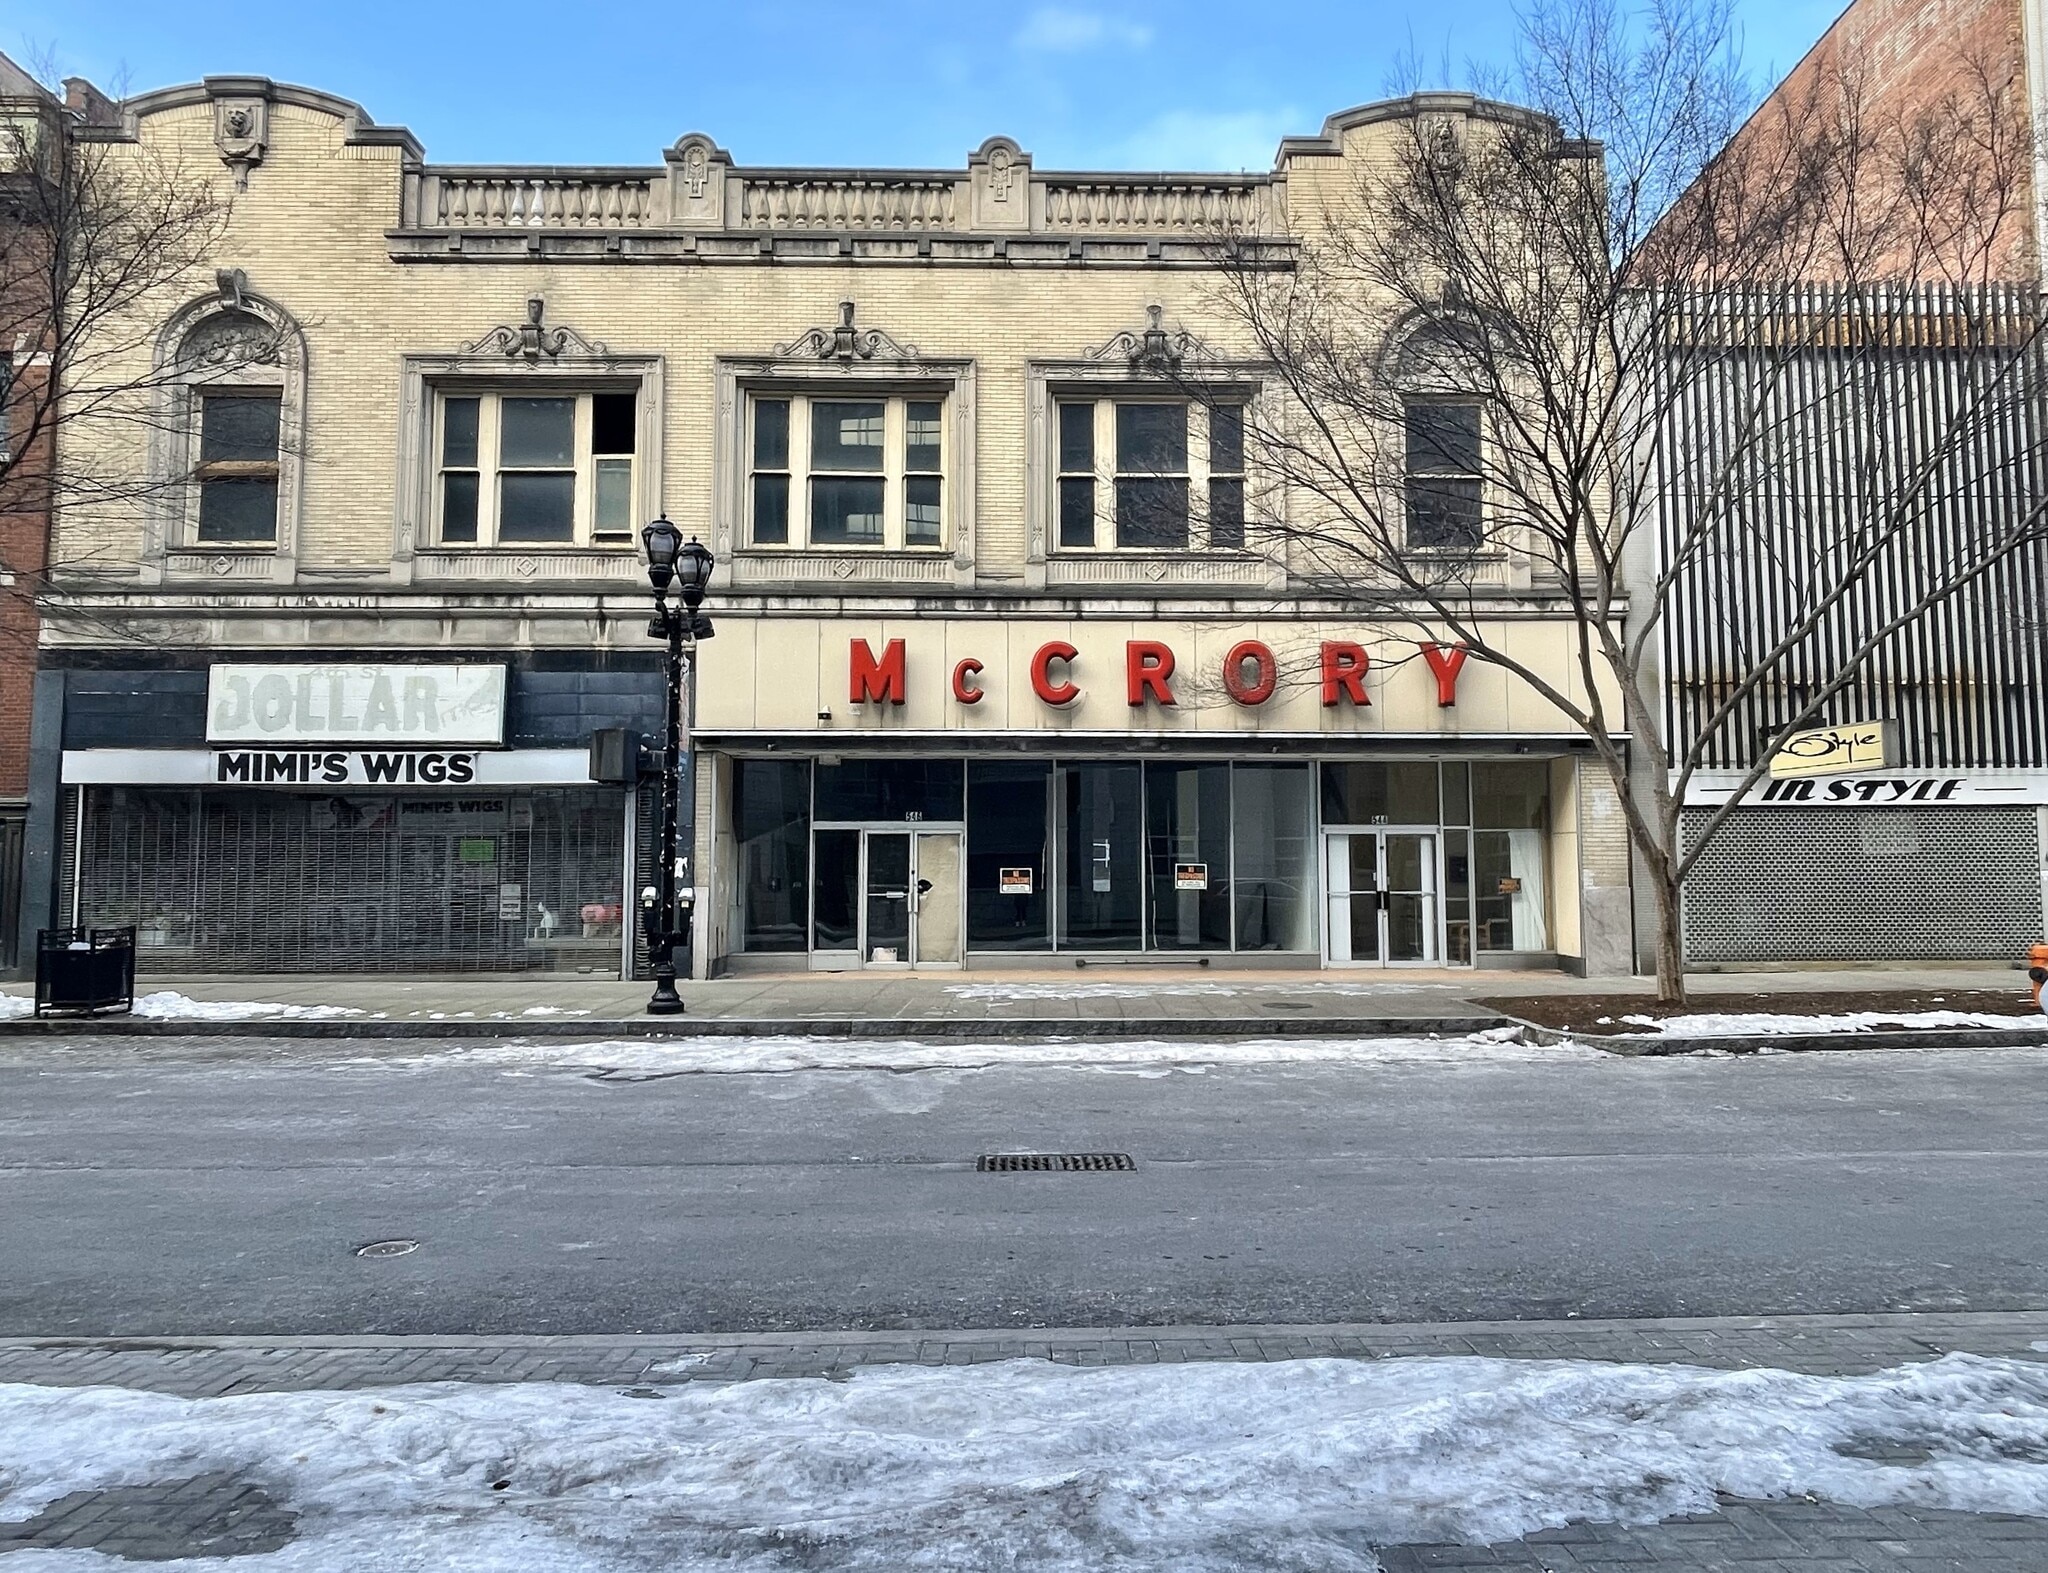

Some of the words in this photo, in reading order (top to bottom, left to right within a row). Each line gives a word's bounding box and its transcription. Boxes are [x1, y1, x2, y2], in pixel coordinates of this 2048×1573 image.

[217, 753, 348, 783] MIMI'S
[360, 753, 474, 783] WIGS
[1823, 779, 1967, 802] STYLE
[459, 800, 504, 813] WIGS
